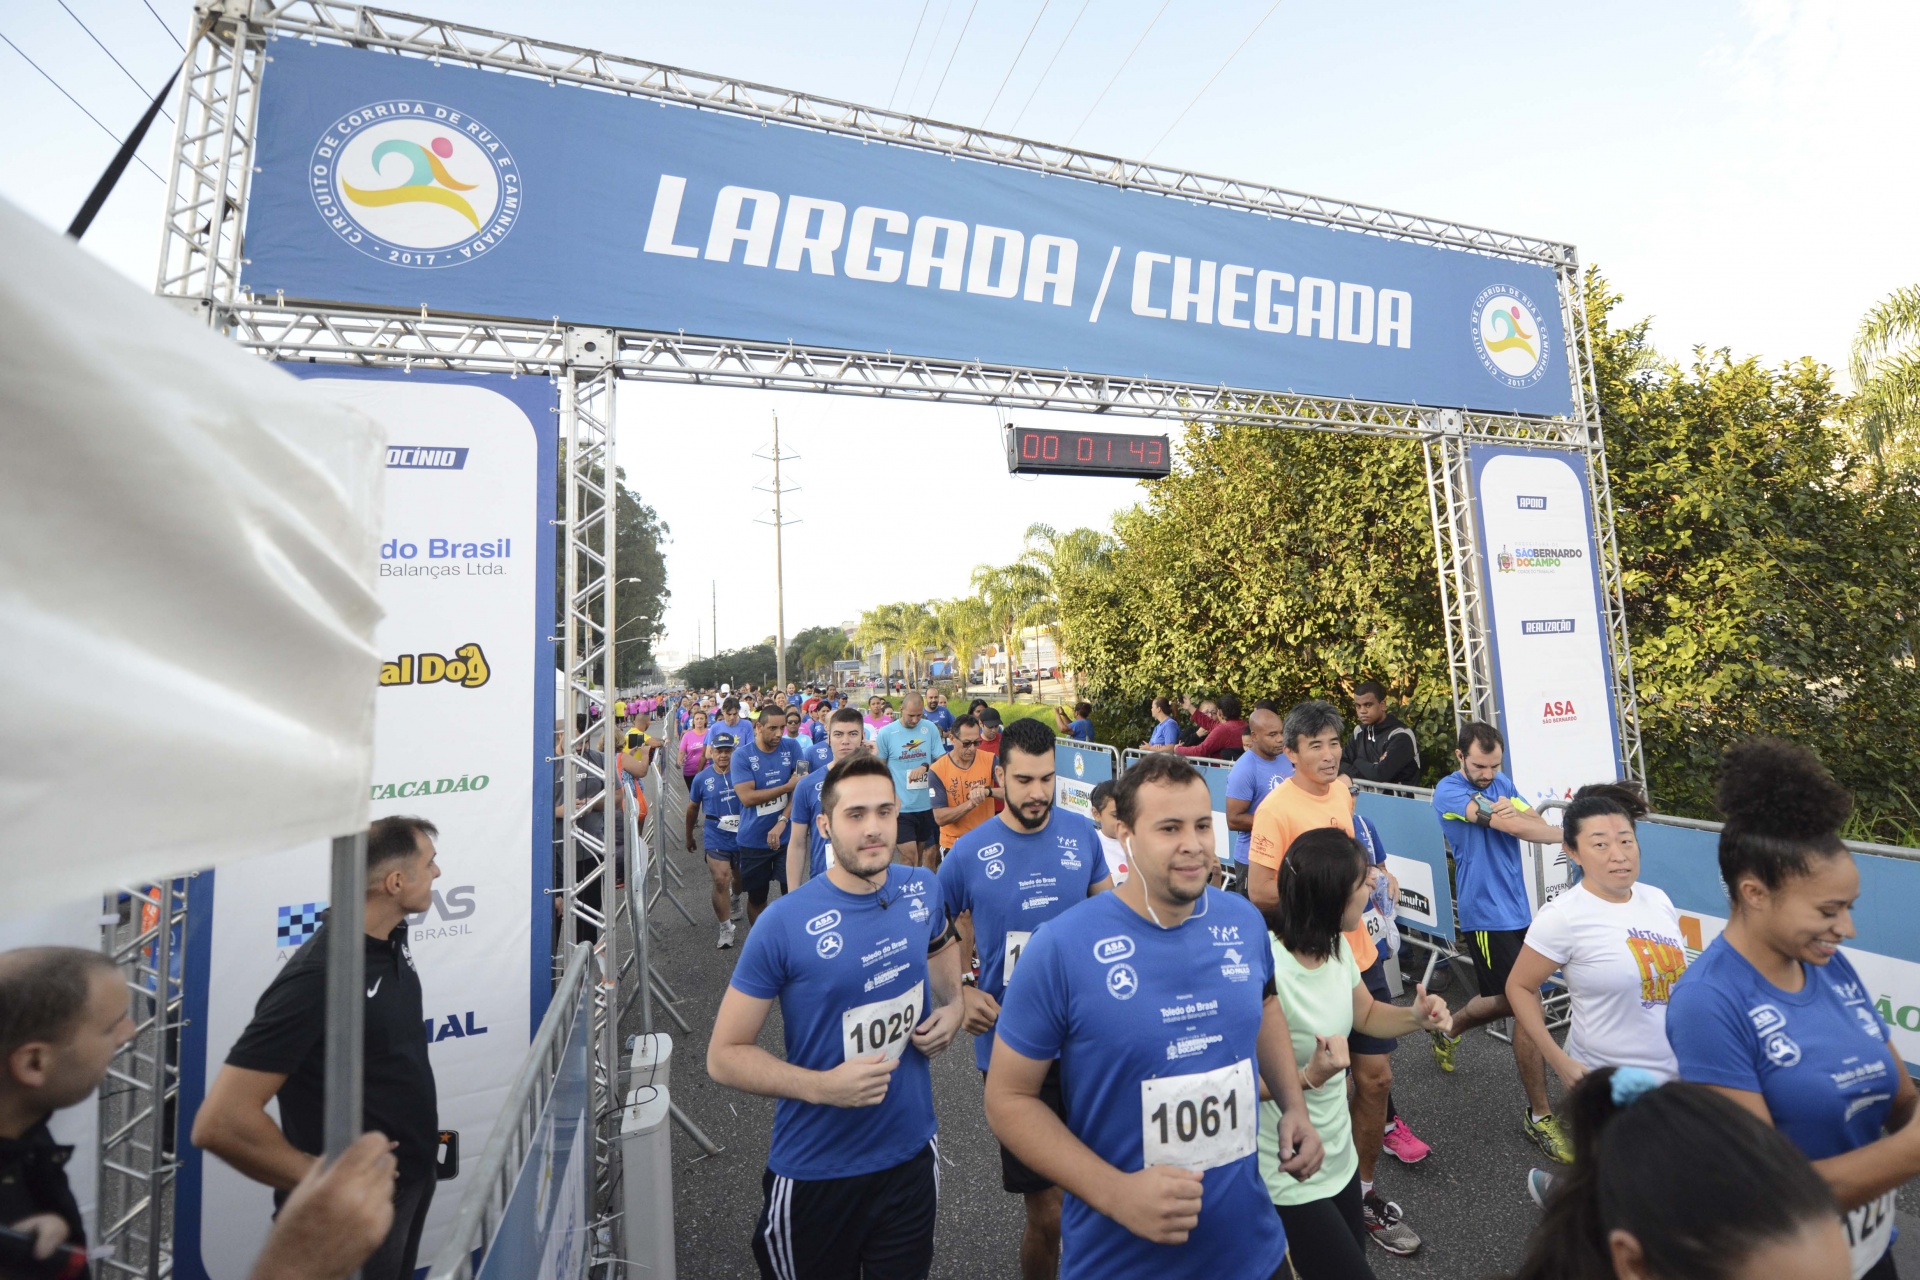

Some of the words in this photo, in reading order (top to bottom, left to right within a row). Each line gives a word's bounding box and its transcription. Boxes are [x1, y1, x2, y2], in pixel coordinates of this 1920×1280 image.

[337, 102, 426, 134] CORRIDA
[434, 107, 462, 125] DE
[318, 135, 340, 159] DE
[466, 122, 501, 154] RUA
[498, 157, 512, 168] E
[313, 164, 363, 244] CIRCUITO
[458, 174, 518, 259] CAMINHADA
[388, 250, 436, 266] 2017
[643, 173, 1079, 308] LARGADA
[1130, 250, 1412, 350] CHEGADA
[1476, 285, 1507, 308] CORRIDA
[1508, 287, 1519, 298] DE
[1521, 295, 1537, 314] RUA
[1472, 310, 1480, 324] DE
[1472, 328, 1498, 376] CIRCUITO
[1532, 326, 1549, 381] CAMINHADA
[1507, 378, 1526, 387] 2017
[1519, 497, 1544, 509] APOIO
[380, 538, 418, 560] do
[428, 538, 511, 559] Brasil
[379, 562, 461, 580] Balanças
[467, 561, 507, 576] Ltda.
[1525, 619, 1572, 633] REALIZAÇÃO
[418, 644, 491, 688] Dog
[1543, 700, 1576, 718] ASA
[414, 923, 473, 942] BRASIL
[1104, 940, 1127, 955] ASA
[1160, 1005, 1185, 1018] Toledo
[1185, 1003, 1196, 1014] do
[1196, 1000, 1219, 1012] Brasil
[850, 1003, 915, 1054] 1029
[1151, 1088, 1238, 1145] 1061
